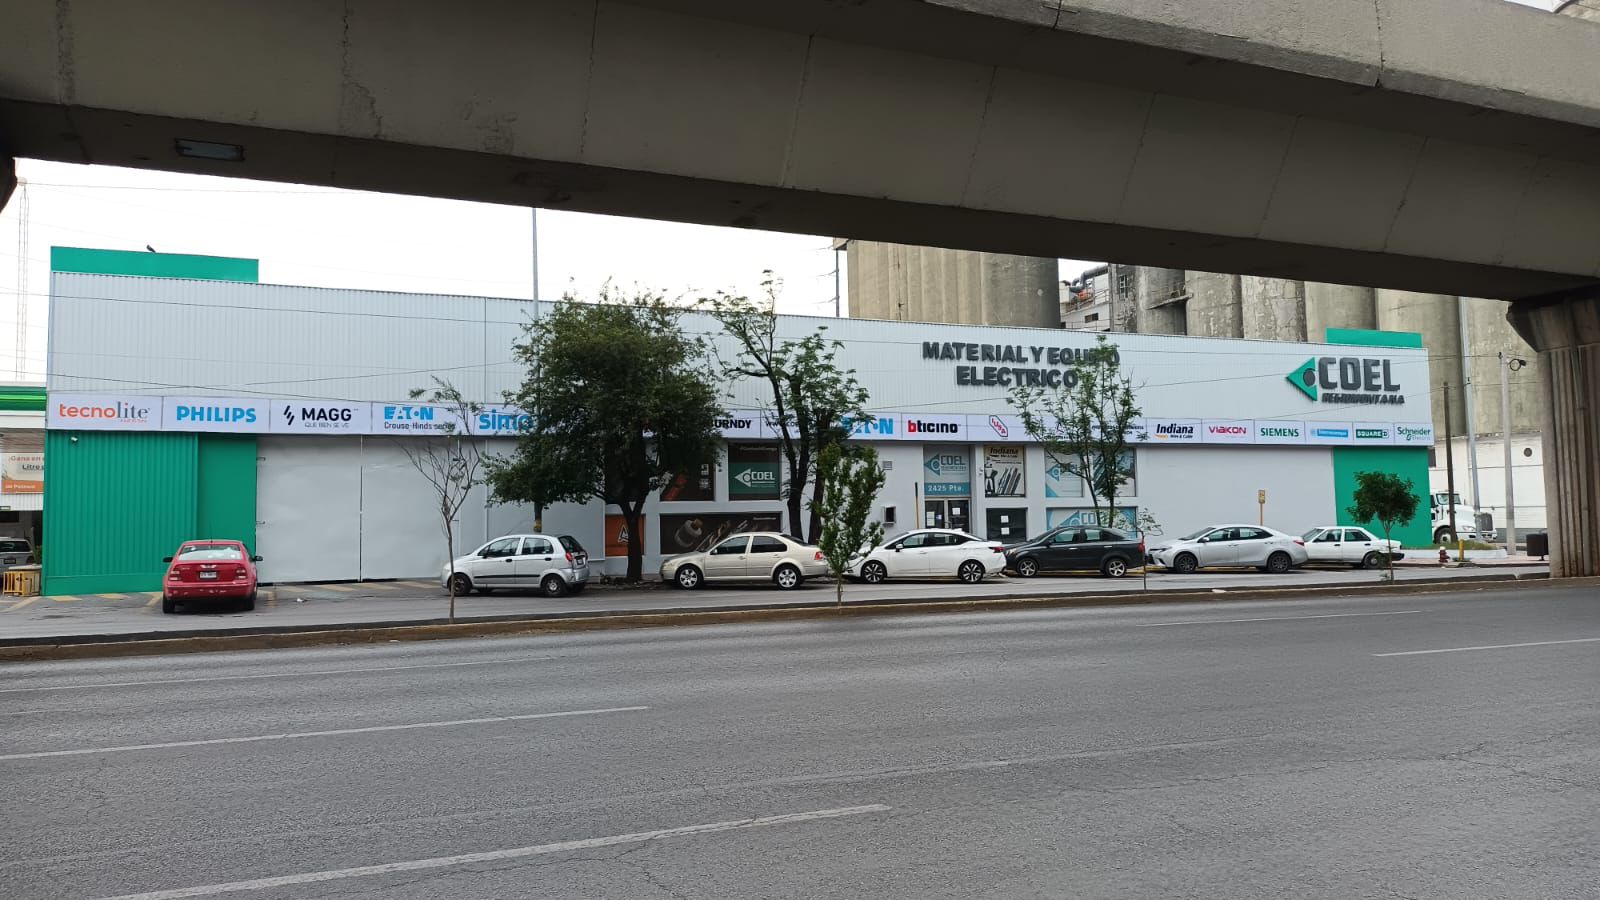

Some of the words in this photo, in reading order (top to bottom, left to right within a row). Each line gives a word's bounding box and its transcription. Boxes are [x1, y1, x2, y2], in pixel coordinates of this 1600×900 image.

[922, 341, 1028, 364] MATERIAL
[1030, 345, 1045, 363] Y
[956, 365, 1079, 389] ELECTRICO
[1318, 357, 1401, 391] COEL
[60, 401, 149, 419] tecnolite
[176, 405, 257, 423] PHILIPS
[302, 407, 352, 421] MAGG
[384, 406, 433, 420] EATON
[479, 408, 540, 431] simo
[710, 419, 751, 429] URNDY
[907, 420, 958, 433] bticino
[1156, 423, 1194, 434] Indiana
[1260, 427, 1300, 437] SIEMENS
[1396, 426, 1431, 436] Schneider
[940, 455, 966, 466] COEL
[751, 471, 776, 481] COEL
